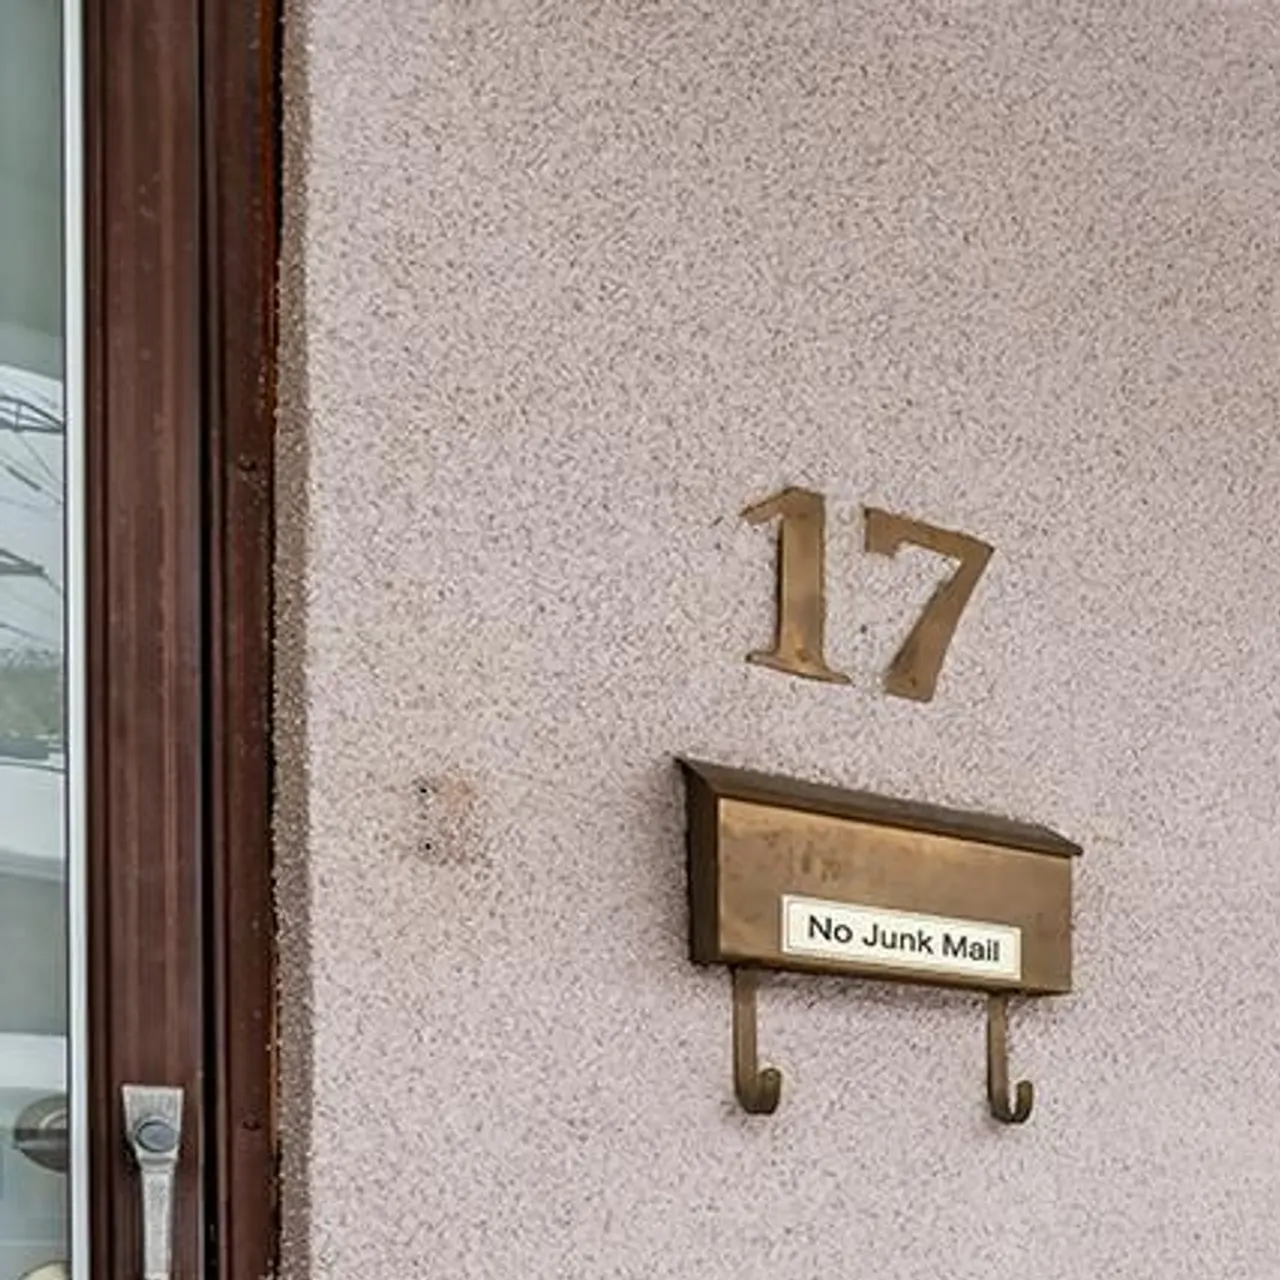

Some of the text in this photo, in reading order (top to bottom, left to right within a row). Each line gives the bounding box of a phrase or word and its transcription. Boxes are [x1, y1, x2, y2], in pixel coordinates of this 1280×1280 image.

[740, 485, 996, 701] 17
[807, 914, 1000, 963] No Junk Mail
